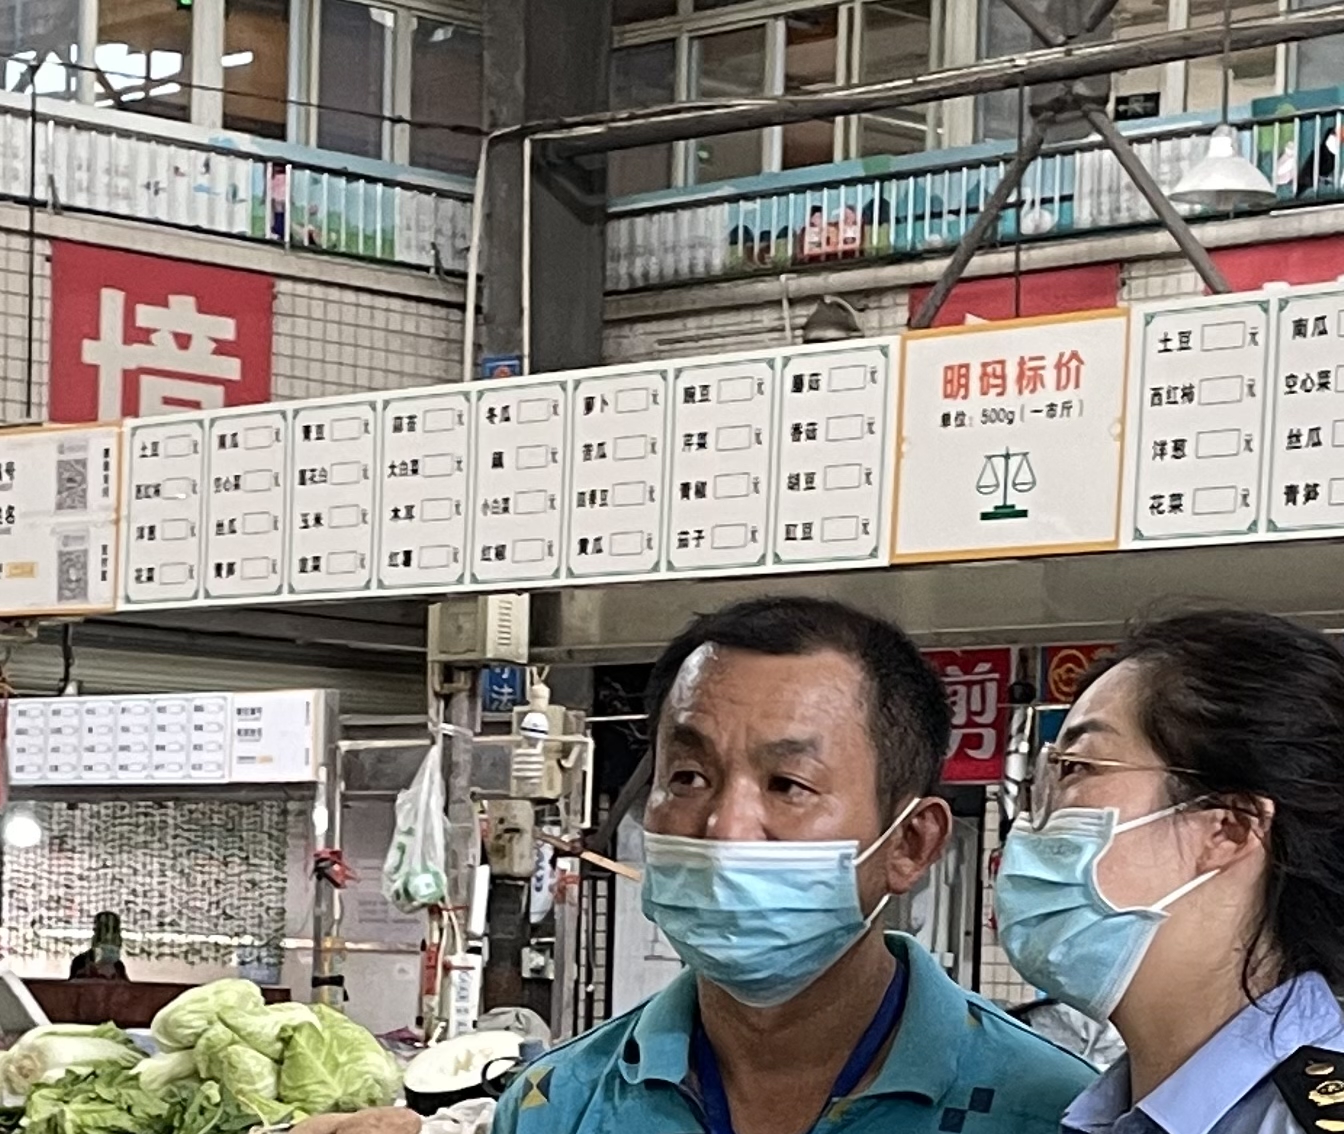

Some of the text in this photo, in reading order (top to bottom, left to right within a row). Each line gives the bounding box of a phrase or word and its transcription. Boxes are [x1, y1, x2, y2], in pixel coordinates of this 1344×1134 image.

[1157, 326, 1258, 353] 土豆 元
[1292, 315, 1328, 340] 南瓜
[942, 350, 1085, 401] 明码标价
[1284, 369, 1331, 395] 空心菜
[1150, 379, 1256, 407] 西红柿 元
[1152, 434, 1253, 461] 洋葱 元
[1286, 427, 1323, 450] 丝瓜
[1149, 489, 1250, 515] 花菜 元
